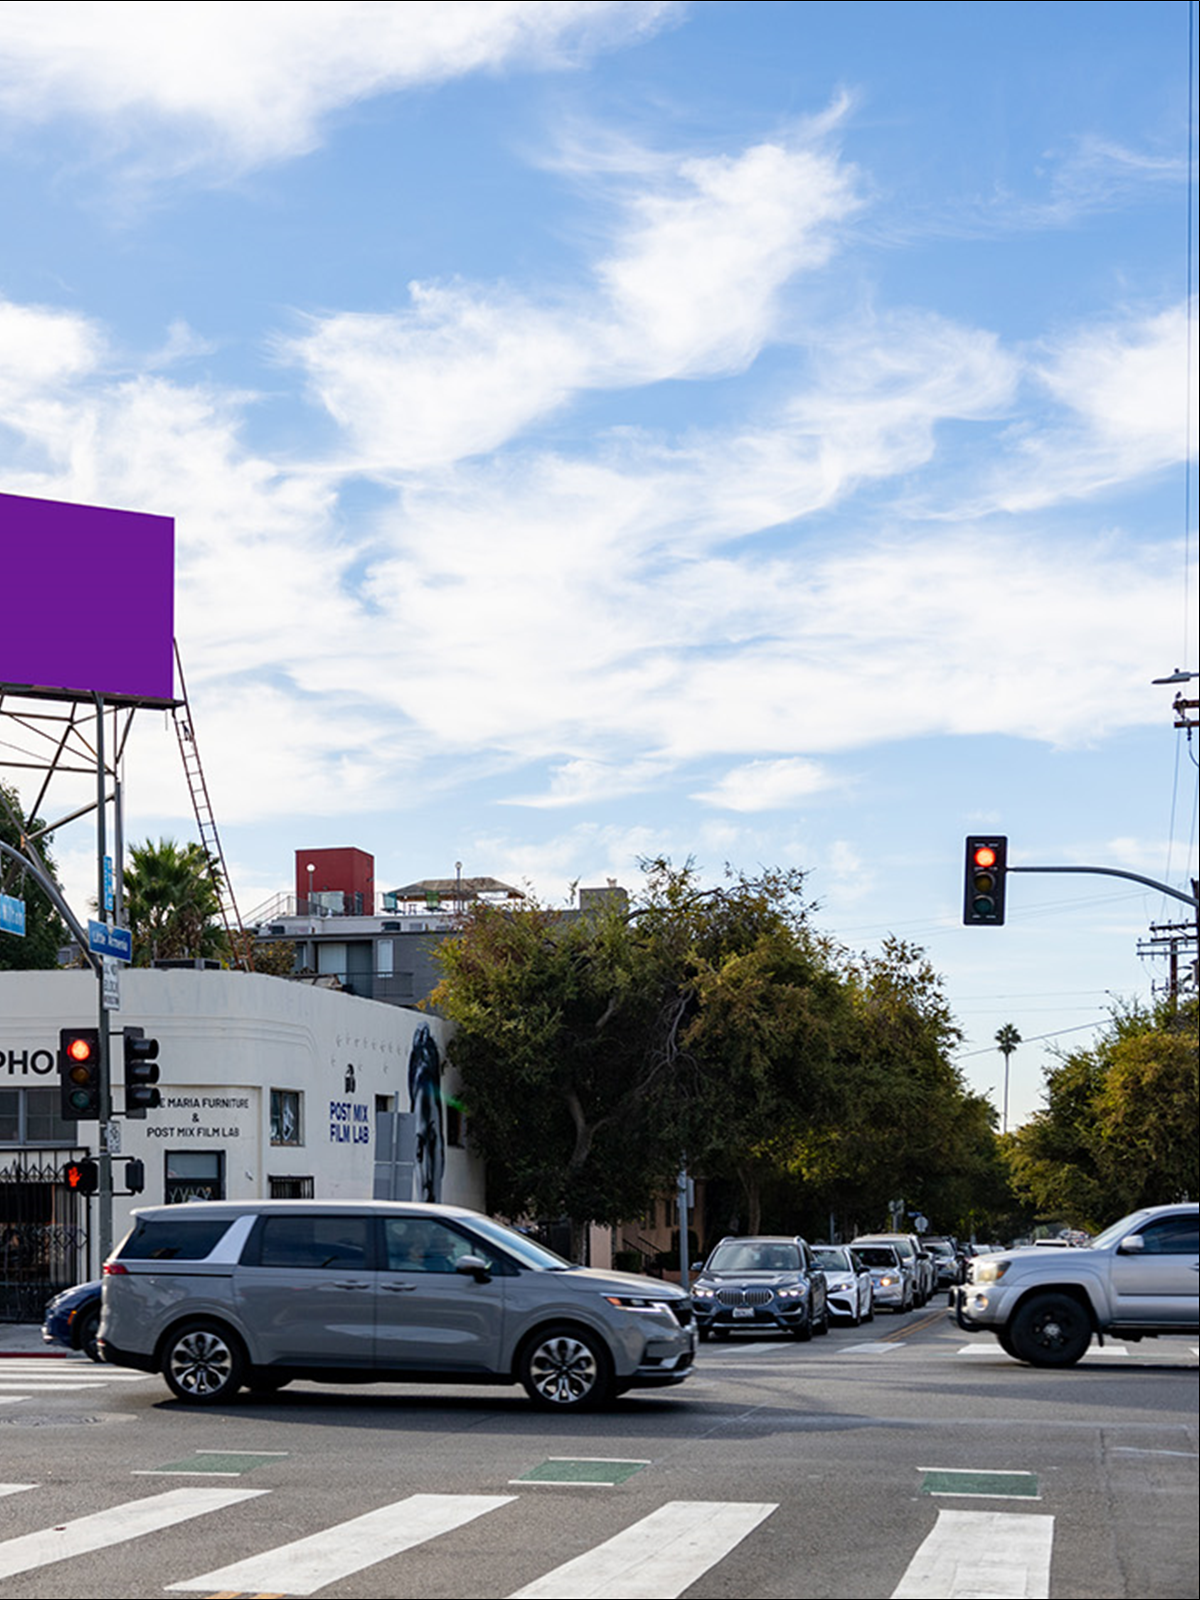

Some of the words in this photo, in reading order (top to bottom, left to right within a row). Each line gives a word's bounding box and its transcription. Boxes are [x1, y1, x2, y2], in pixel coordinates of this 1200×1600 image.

[167, 1098, 200, 1108] MARIA
[202, 1097, 249, 1109] FURNITURE
[192, 1113, 199, 1122] &
[330, 1101, 351, 1121] POST
[353, 1104, 369, 1122] MIX
[146, 1127, 175, 1138] POST
[177, 1127, 195, 1137] MIX
[197, 1127, 220, 1138] FILM
[222, 1127, 240, 1138] LAB
[330, 1123, 350, 1142] FILM
[353, 1125, 369, 1144] LAB
